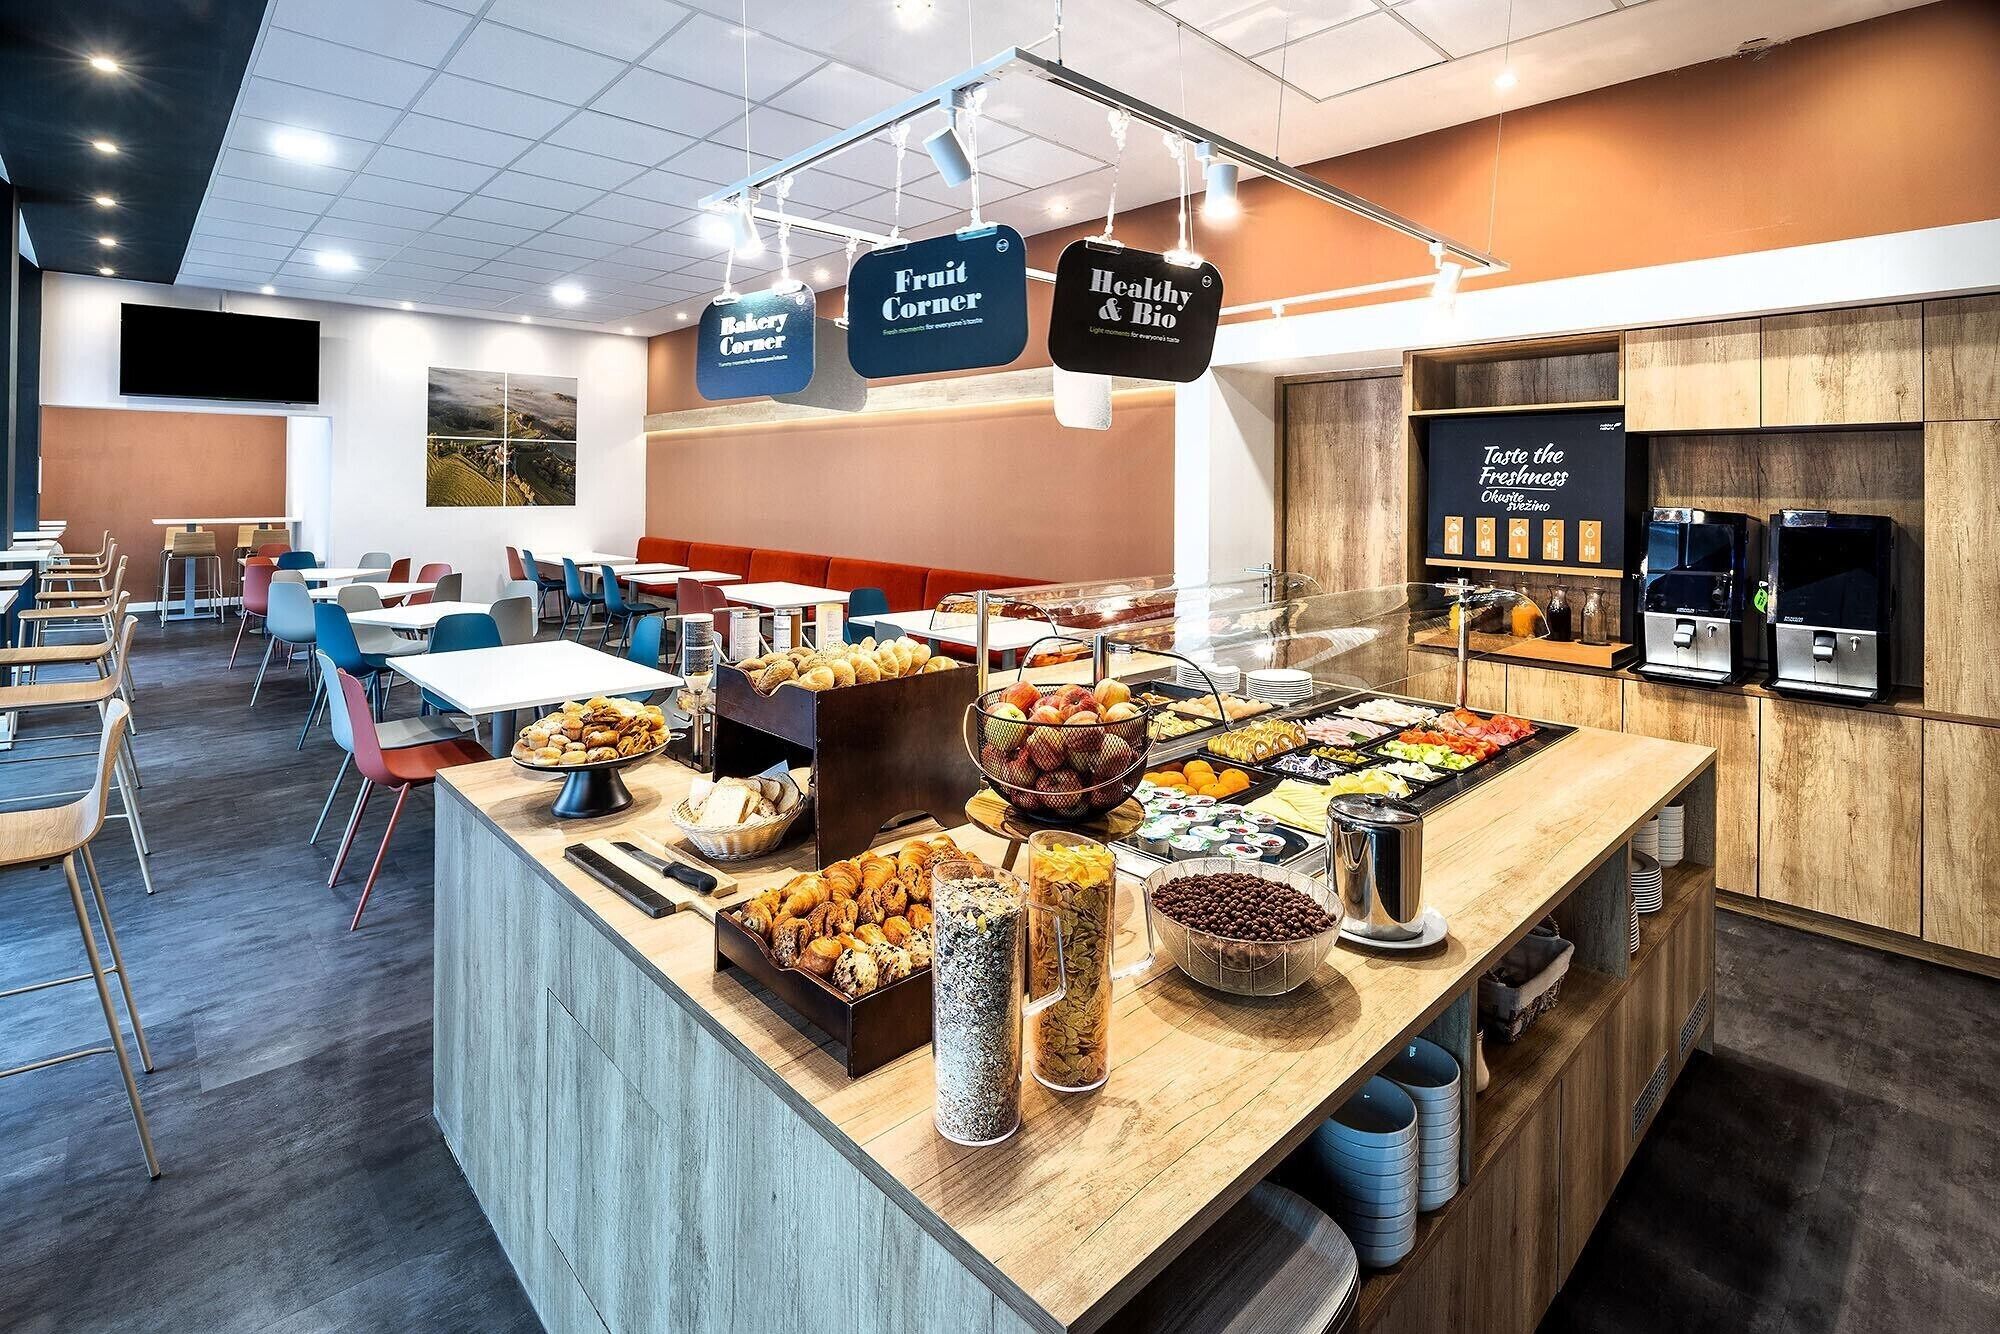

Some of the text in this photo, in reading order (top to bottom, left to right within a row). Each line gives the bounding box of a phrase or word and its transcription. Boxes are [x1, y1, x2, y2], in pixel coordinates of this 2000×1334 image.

[894, 260, 969, 294] Fruit
[1089, 267, 1193, 312] Healthy
[882, 292, 983, 321] Corner
[1098, 297, 1177, 329] & Bio
[720, 313, 789, 336] Bakery
[898, 324, 926, 335] moments
[925, 323, 935, 331] for
[1089, 325, 1105, 335] Light
[1104, 328, 1131, 338] moments
[1130, 331, 1139, 339] for
[720, 335, 787, 356] Corner
[1483, 442, 1565, 466] Taste the
[1478, 464, 1570, 487] Freshness
[1480, 489, 1525, 504] Okusite
[1505, 499, 1551, 512] svežino
